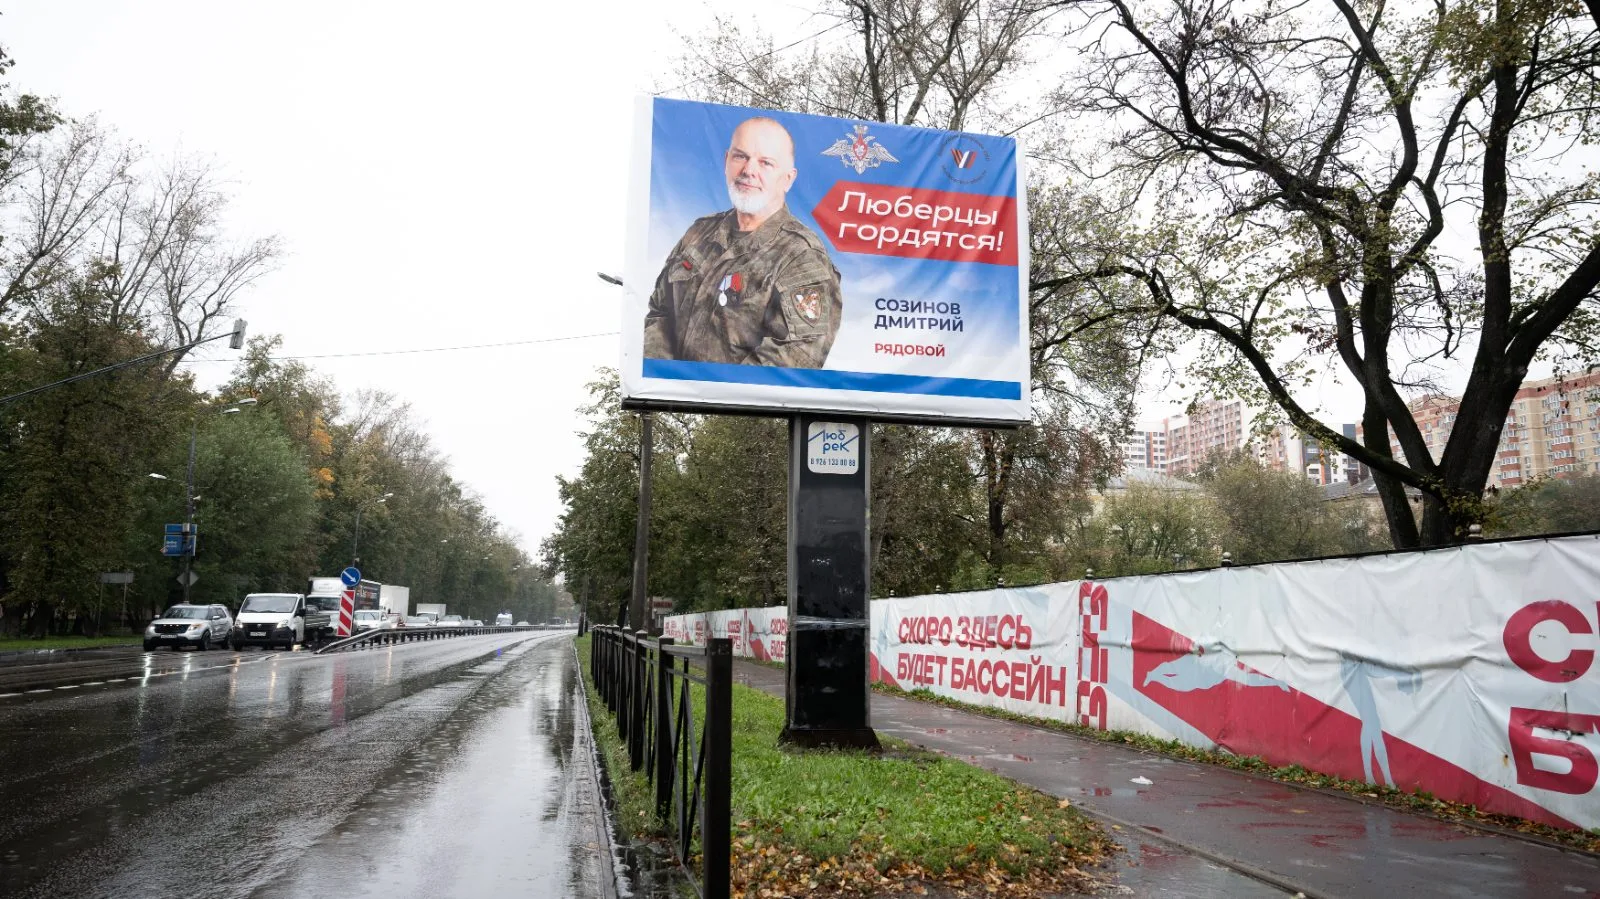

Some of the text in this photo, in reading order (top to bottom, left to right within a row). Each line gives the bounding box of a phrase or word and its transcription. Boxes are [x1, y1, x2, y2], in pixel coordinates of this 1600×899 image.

[838, 191, 997, 229] Люберцы
[838, 222, 1004, 252] гордятся!
[874, 314, 963, 333] ДМИТРИЙ
[875, 298, 961, 315] СОЗИНОВ
[874, 342, 946, 357] РЯДОВОЙ
[898, 614, 1032, 652] СКОРО ЗДЕСЬ
[1503, 600, 1600, 683] С
[897, 652, 1067, 707] БУДЕТ БАССЕЙН
[1508, 707, 1600, 795] Б
